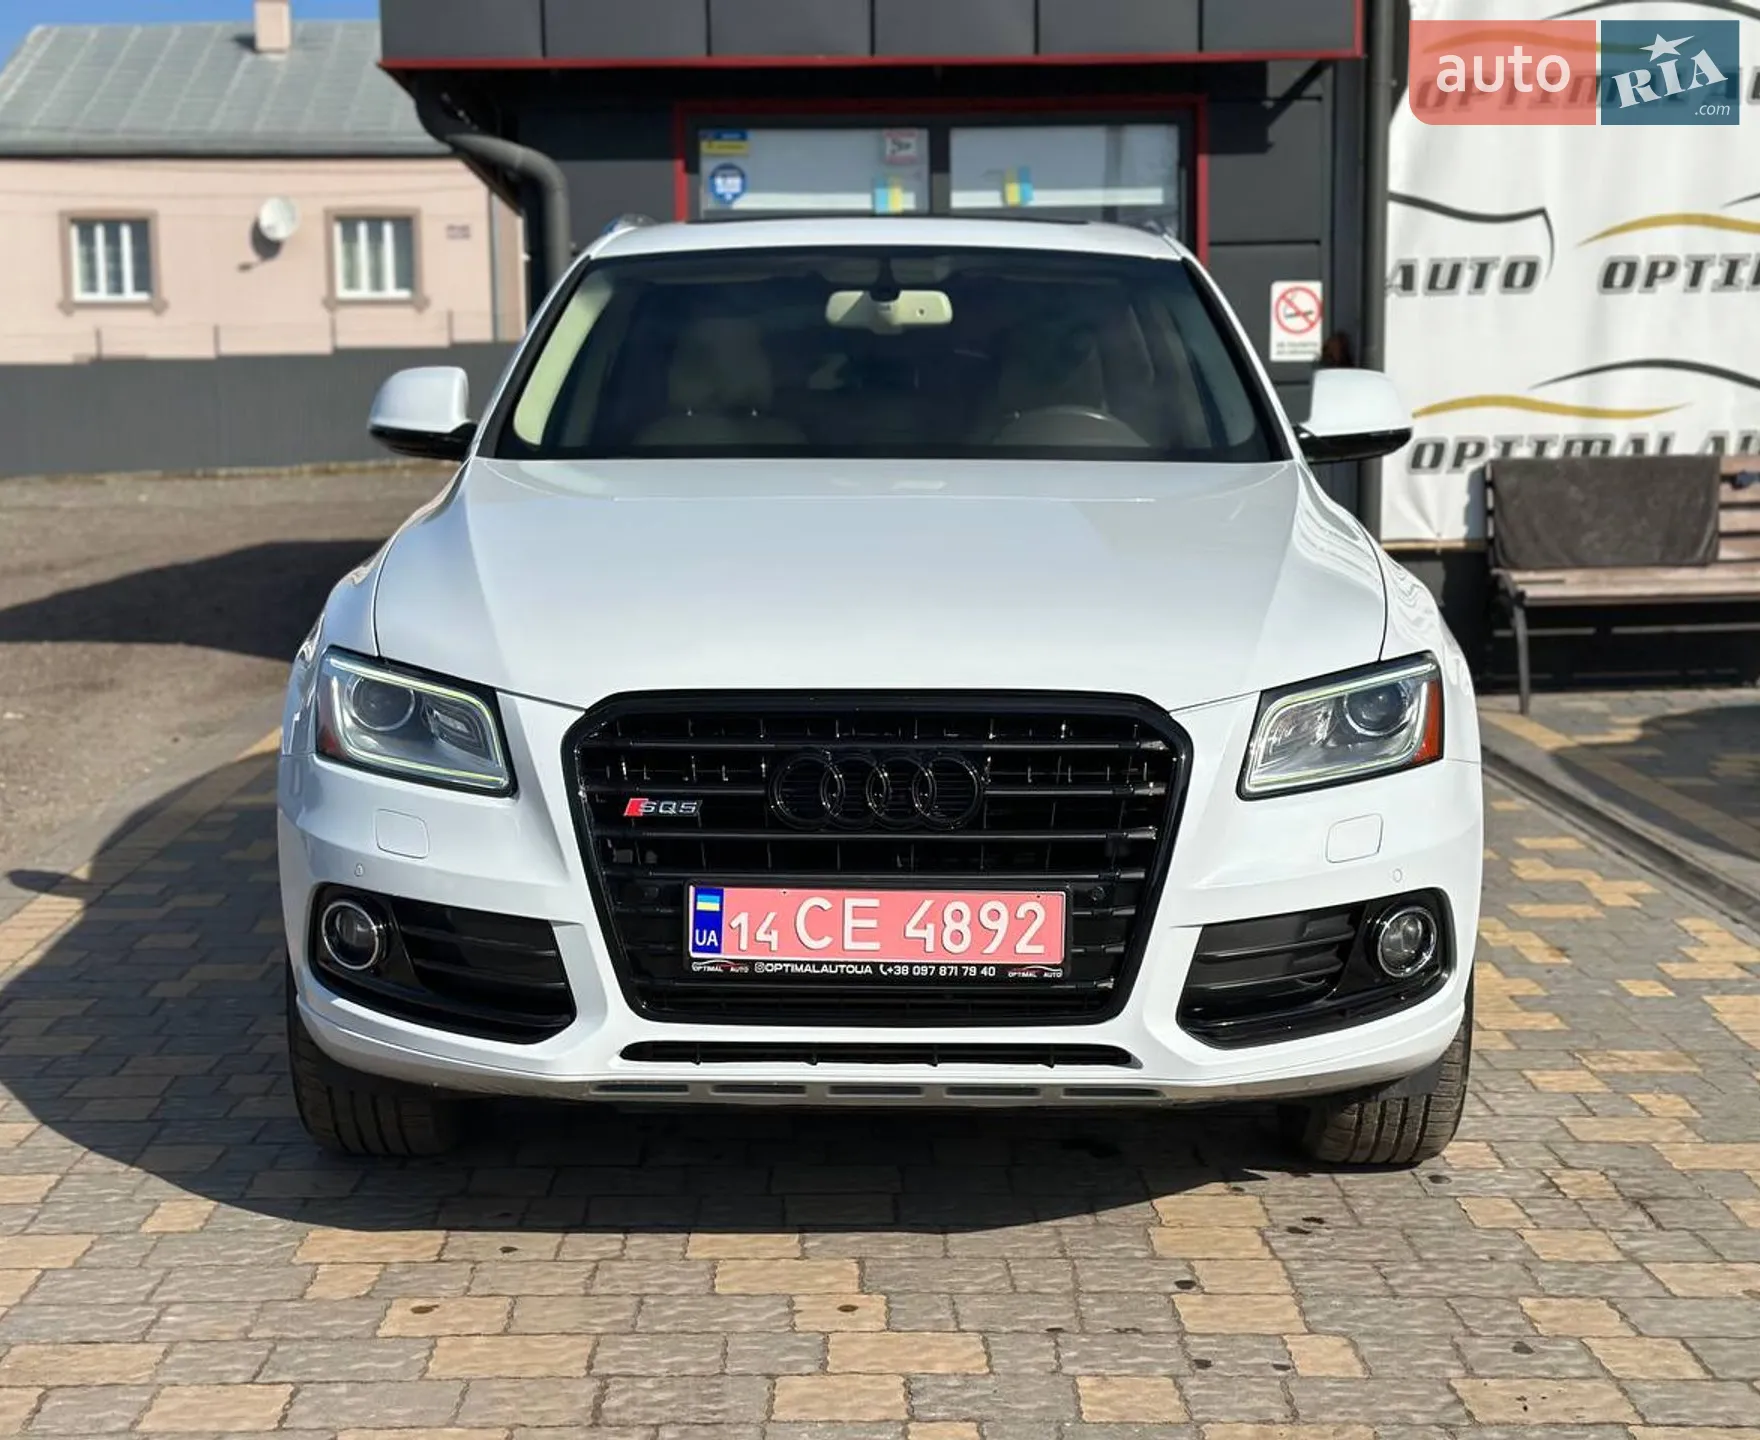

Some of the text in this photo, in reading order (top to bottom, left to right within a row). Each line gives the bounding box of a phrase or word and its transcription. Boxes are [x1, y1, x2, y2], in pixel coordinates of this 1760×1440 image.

[1386, 256, 1542, 297] AUTO
[1597, 252, 1760, 295] OPTI
[638, 801, 698, 814] SQ5
[695, 929, 718, 947] UA
[729, 897, 1046, 955] 14 CE 4892
[912, 966, 936, 976] 097
[939, 966, 958, 977] 871
[961, 967, 976, 977] 79
[980, 967, 996, 977] 40
